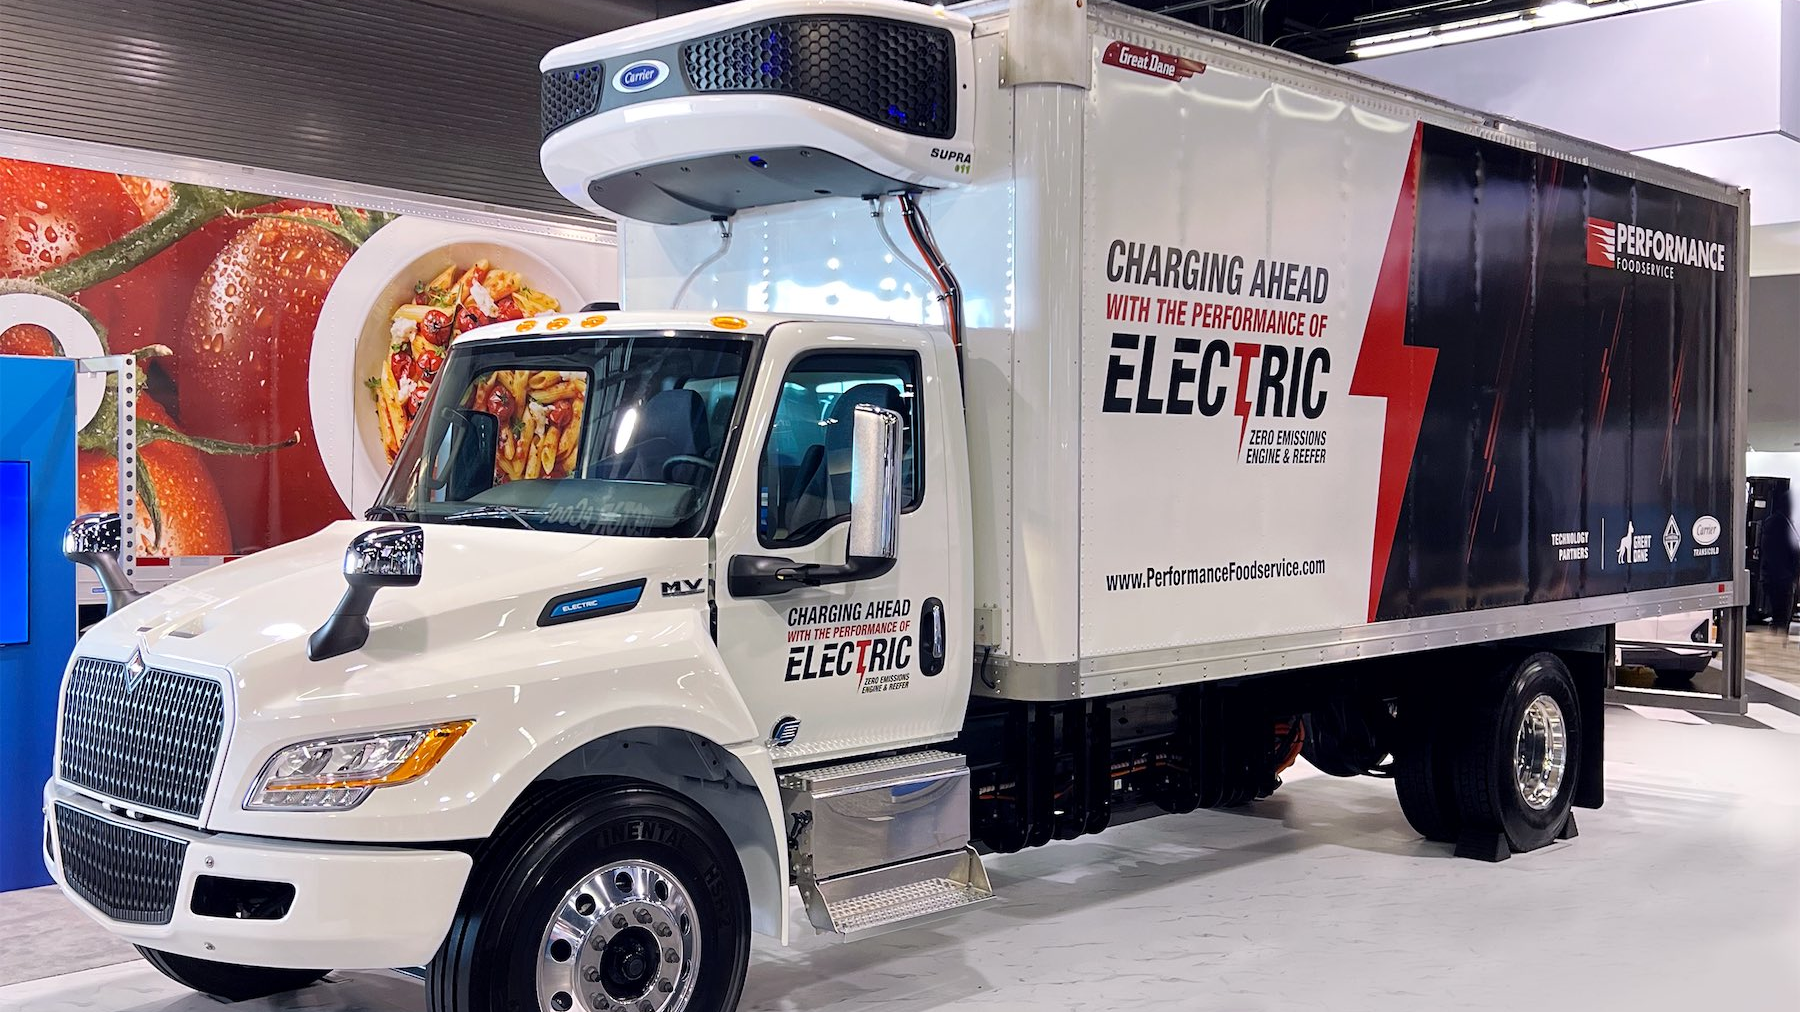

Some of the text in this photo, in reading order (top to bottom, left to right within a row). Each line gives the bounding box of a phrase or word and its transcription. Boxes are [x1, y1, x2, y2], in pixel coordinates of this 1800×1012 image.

[1119, 46, 1175, 76] Great Dane
[625, 69, 655, 84] Carrier
[930, 148, 971, 163] SUPRA
[1617, 222, 1725, 272] PERFORMANCE
[1106, 239, 1329, 304] CHARGING AHEAD
[1617, 257, 1674, 279] FOODSERVICE
[1106, 293, 1328, 338] WITH THE PERFORMANCE OF
[1102, 332, 1331, 420] ELECTRIC
[1249, 430, 1326, 445] ZERO EMISSIONS
[1246, 448, 1326, 464] ENGINE & REEFER
[1696, 524, 1717, 536] Carrier
[1551, 532, 1589, 546] TECHNOLOGY
[1633, 535, 1652, 549] GREAT
[1559, 547, 1589, 561] PARTNERS
[1633, 549, 1648, 563] DANE
[1106, 558, 1326, 591] www.PerformanceFoodservice.com
[661, 578, 703, 593] MV
[562, 600, 598, 612] ELECTRIC
[788, 599, 911, 626] CHARGING AHEAD
[787, 620, 911, 643] WITH THE PERFORMANCE OF
[784, 635, 912, 682] ELECTRIC
[864, 673, 910, 686] ZERO EMISSIONS
[861, 681, 910, 694] ENGINE & REEFER
